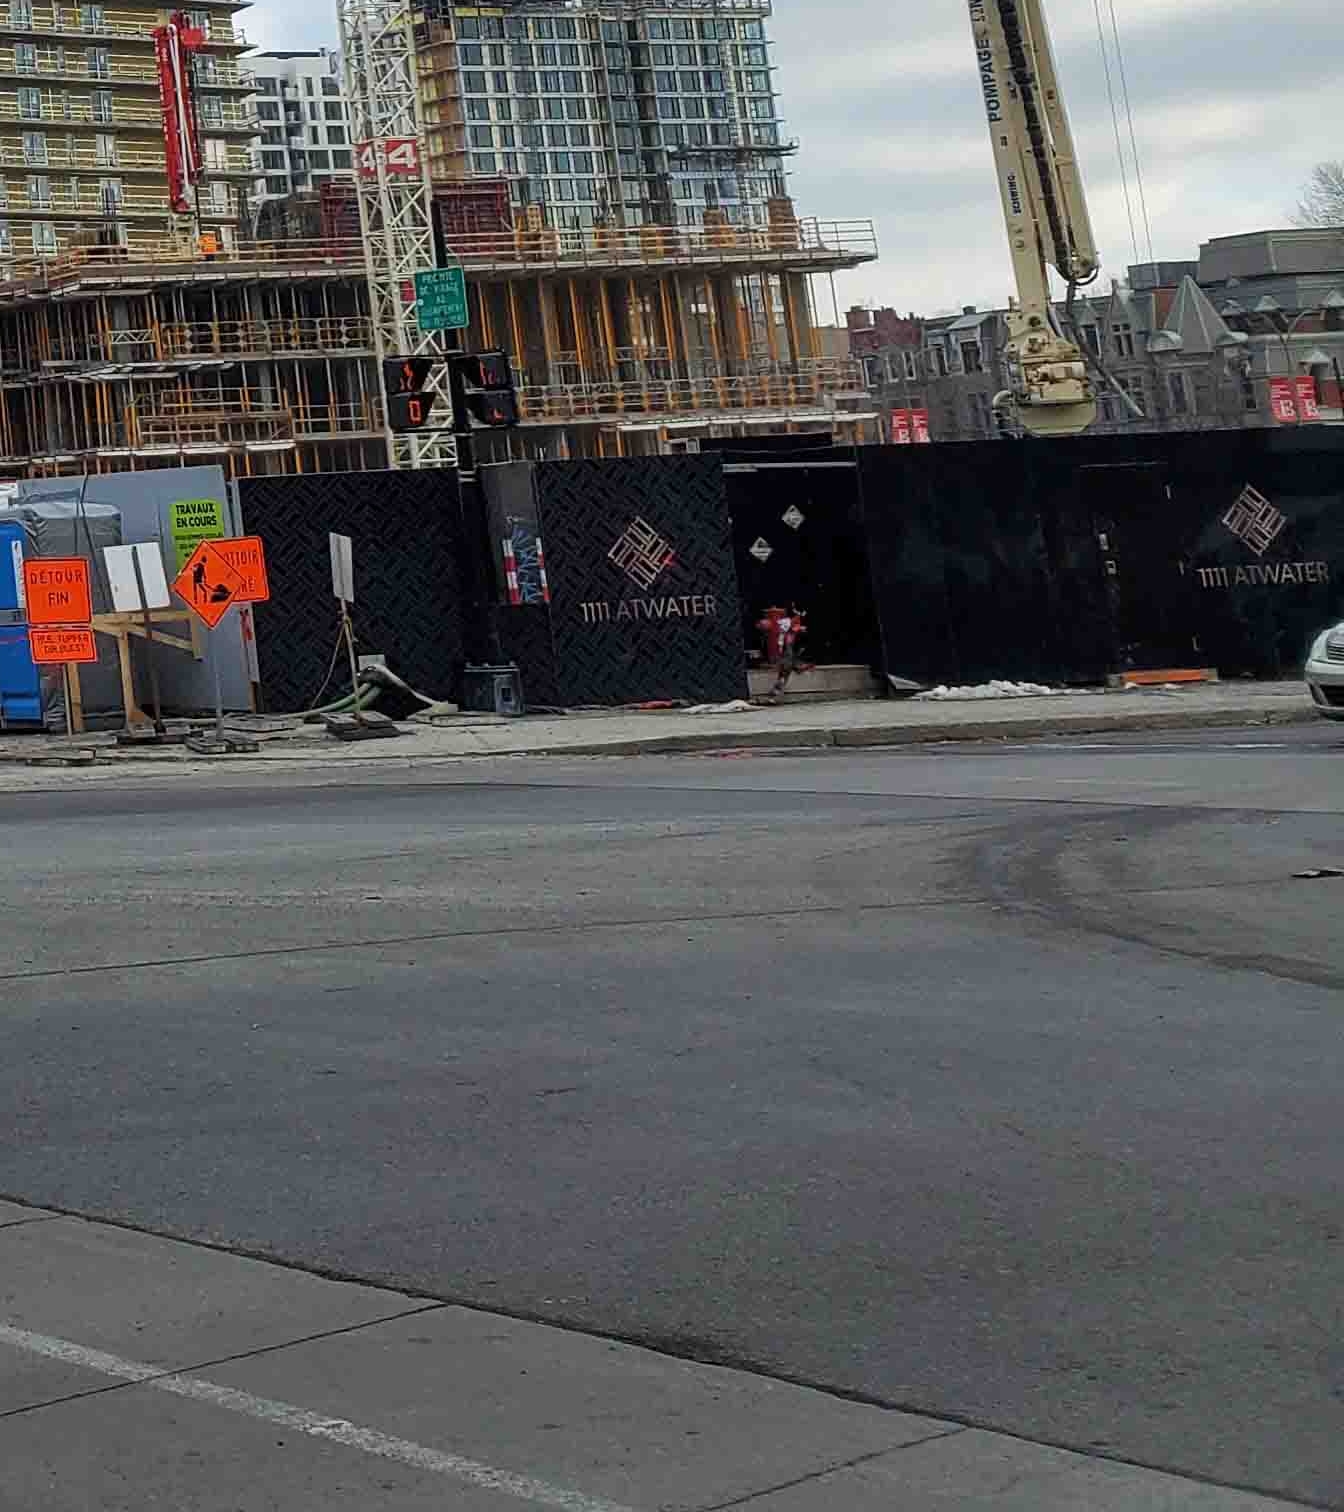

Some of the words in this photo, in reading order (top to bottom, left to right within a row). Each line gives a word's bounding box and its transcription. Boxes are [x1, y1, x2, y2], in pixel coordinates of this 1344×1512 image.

[175, 503, 216, 515] TRAVAUX
[176, 517, 188, 529] EN
[189, 515, 217, 527] COURS
[1196, 567, 1229, 588] 1111
[1234, 561, 1328, 585] ATWATER
[48, 591, 69, 606] FIN
[580, 601, 610, 623] 1111
[616, 595, 717, 621] ATWATER
